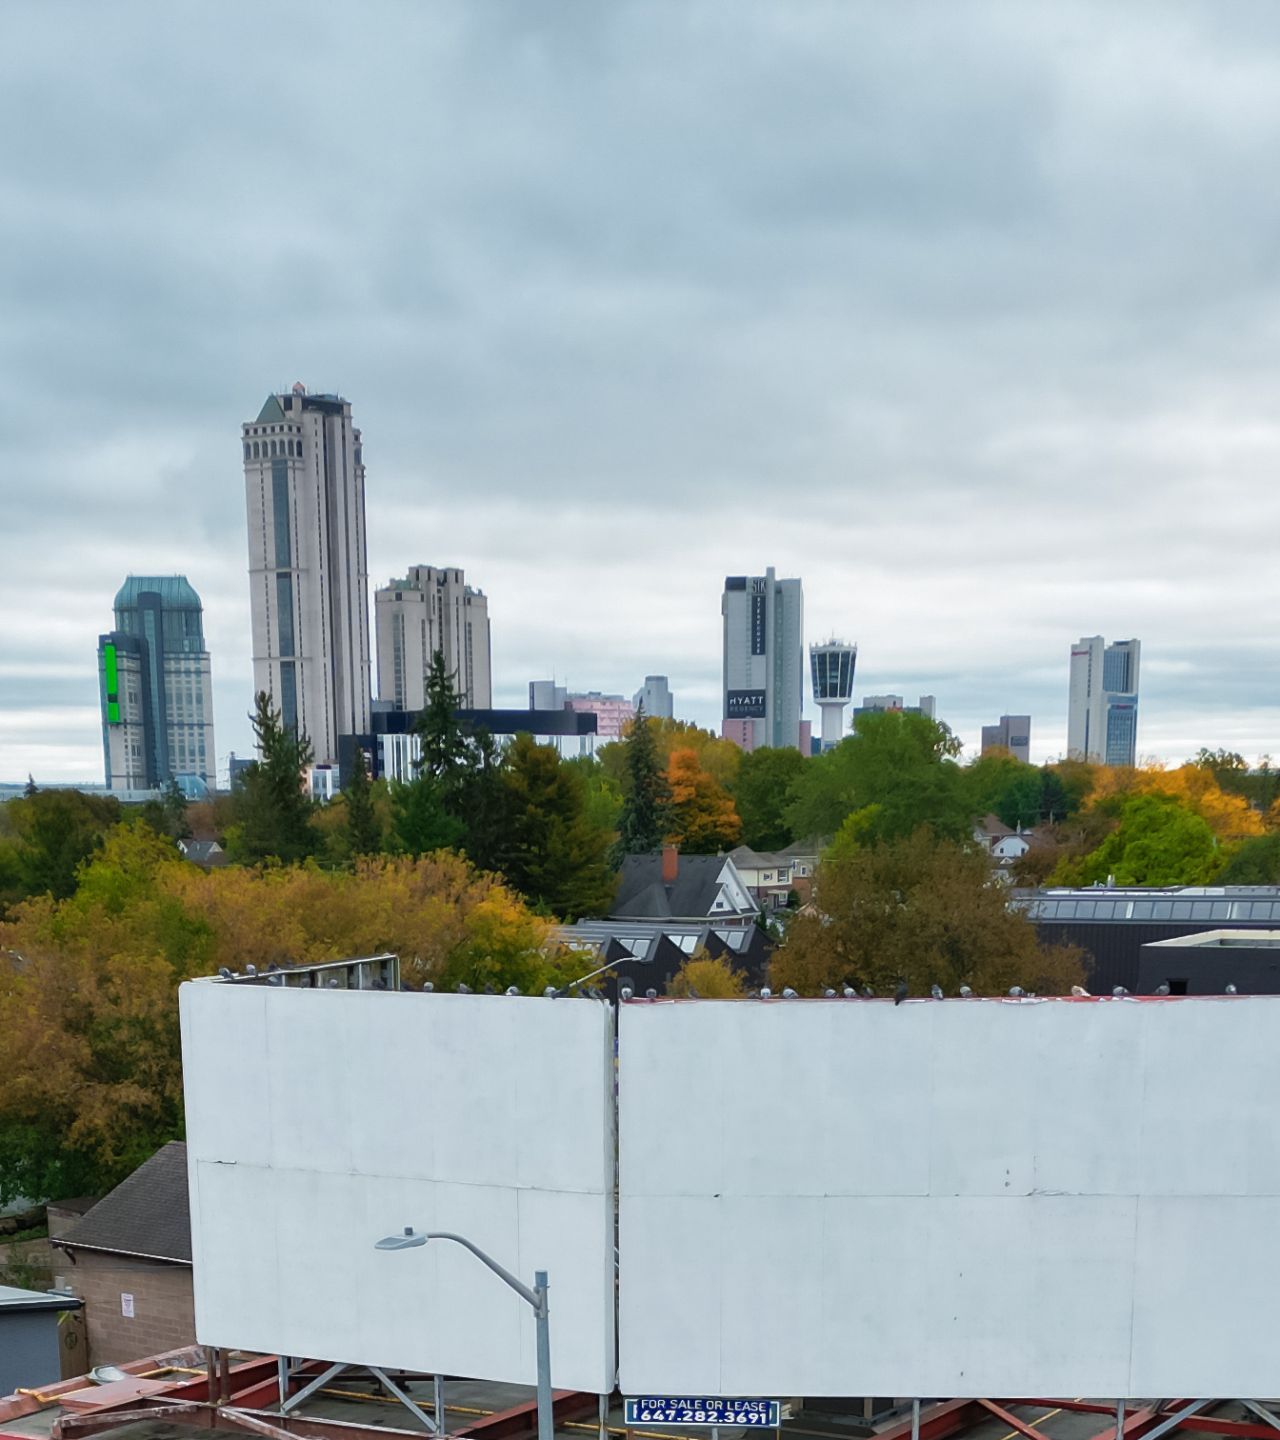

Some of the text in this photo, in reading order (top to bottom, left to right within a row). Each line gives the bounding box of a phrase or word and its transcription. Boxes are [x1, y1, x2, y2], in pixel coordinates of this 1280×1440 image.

[729, 696, 764, 705] HYATT
[641, 1399, 767, 1412] FOR SALE OR LEASE
[640, 1410, 767, 1425] 647.282.3691
